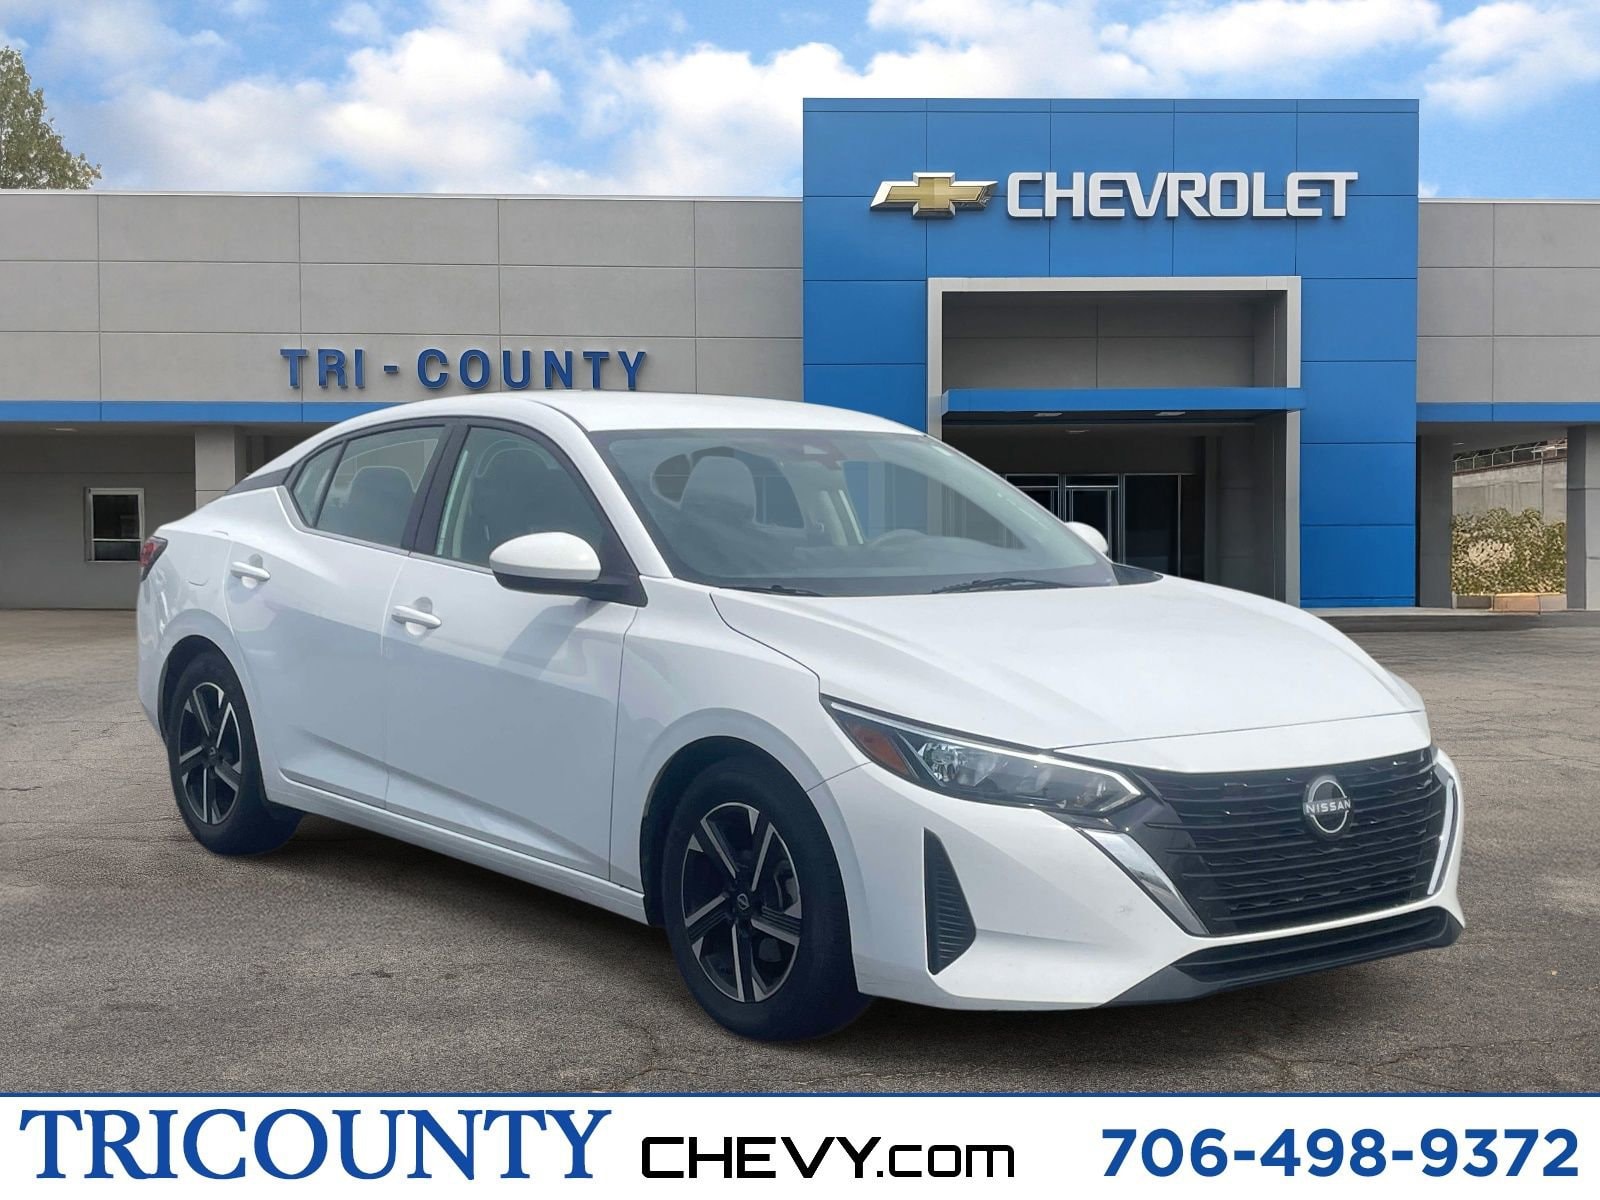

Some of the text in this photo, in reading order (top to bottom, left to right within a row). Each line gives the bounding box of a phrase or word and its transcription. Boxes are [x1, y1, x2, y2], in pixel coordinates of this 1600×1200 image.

[1007, 171, 1358, 218] CHEVROLET
[280, 348, 366, 390] TRI
[416, 348, 647, 391] COUNTY
[1306, 799, 1351, 813] NISSAN
